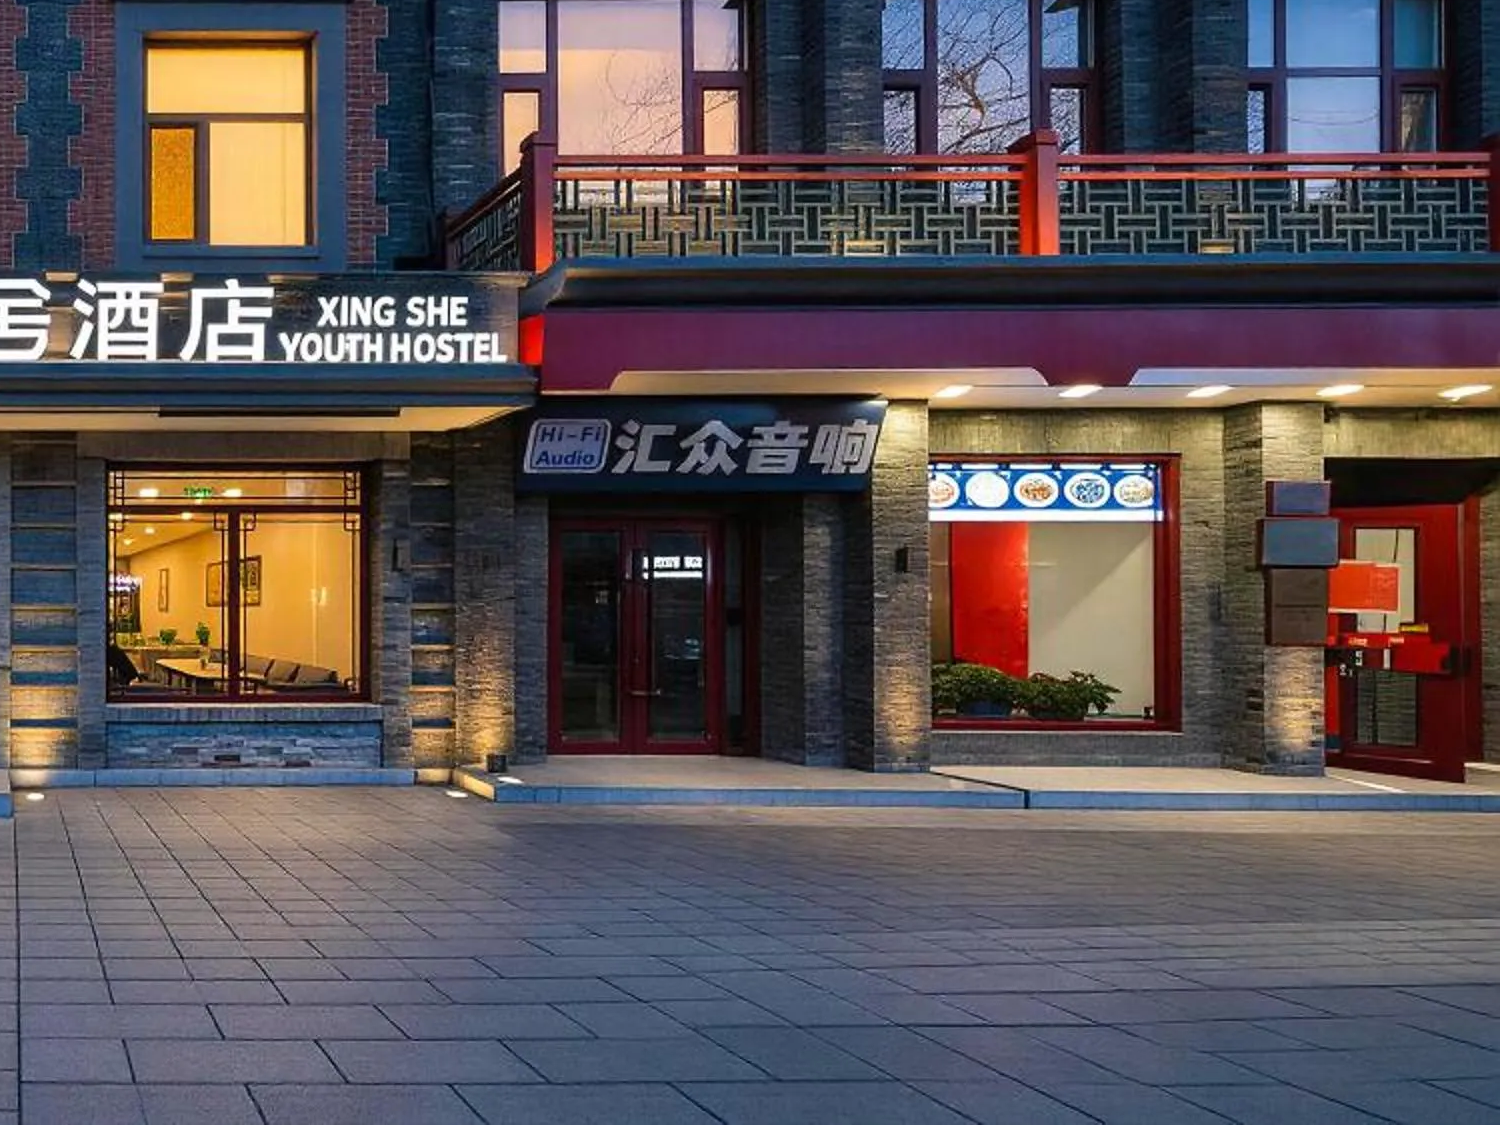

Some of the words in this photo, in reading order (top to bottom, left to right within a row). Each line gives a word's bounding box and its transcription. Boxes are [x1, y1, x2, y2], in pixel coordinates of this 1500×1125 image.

[317, 296, 396, 327] XING
[406, 296, 469, 327] SHE
[279, 332, 383, 363] YOUTH
[390, 332, 508, 364] HOSTEL
[540, 426, 601, 443] Hi-Fi
[611, 418, 879, 475] 汇众音响
[536, 450, 595, 466] Audio
